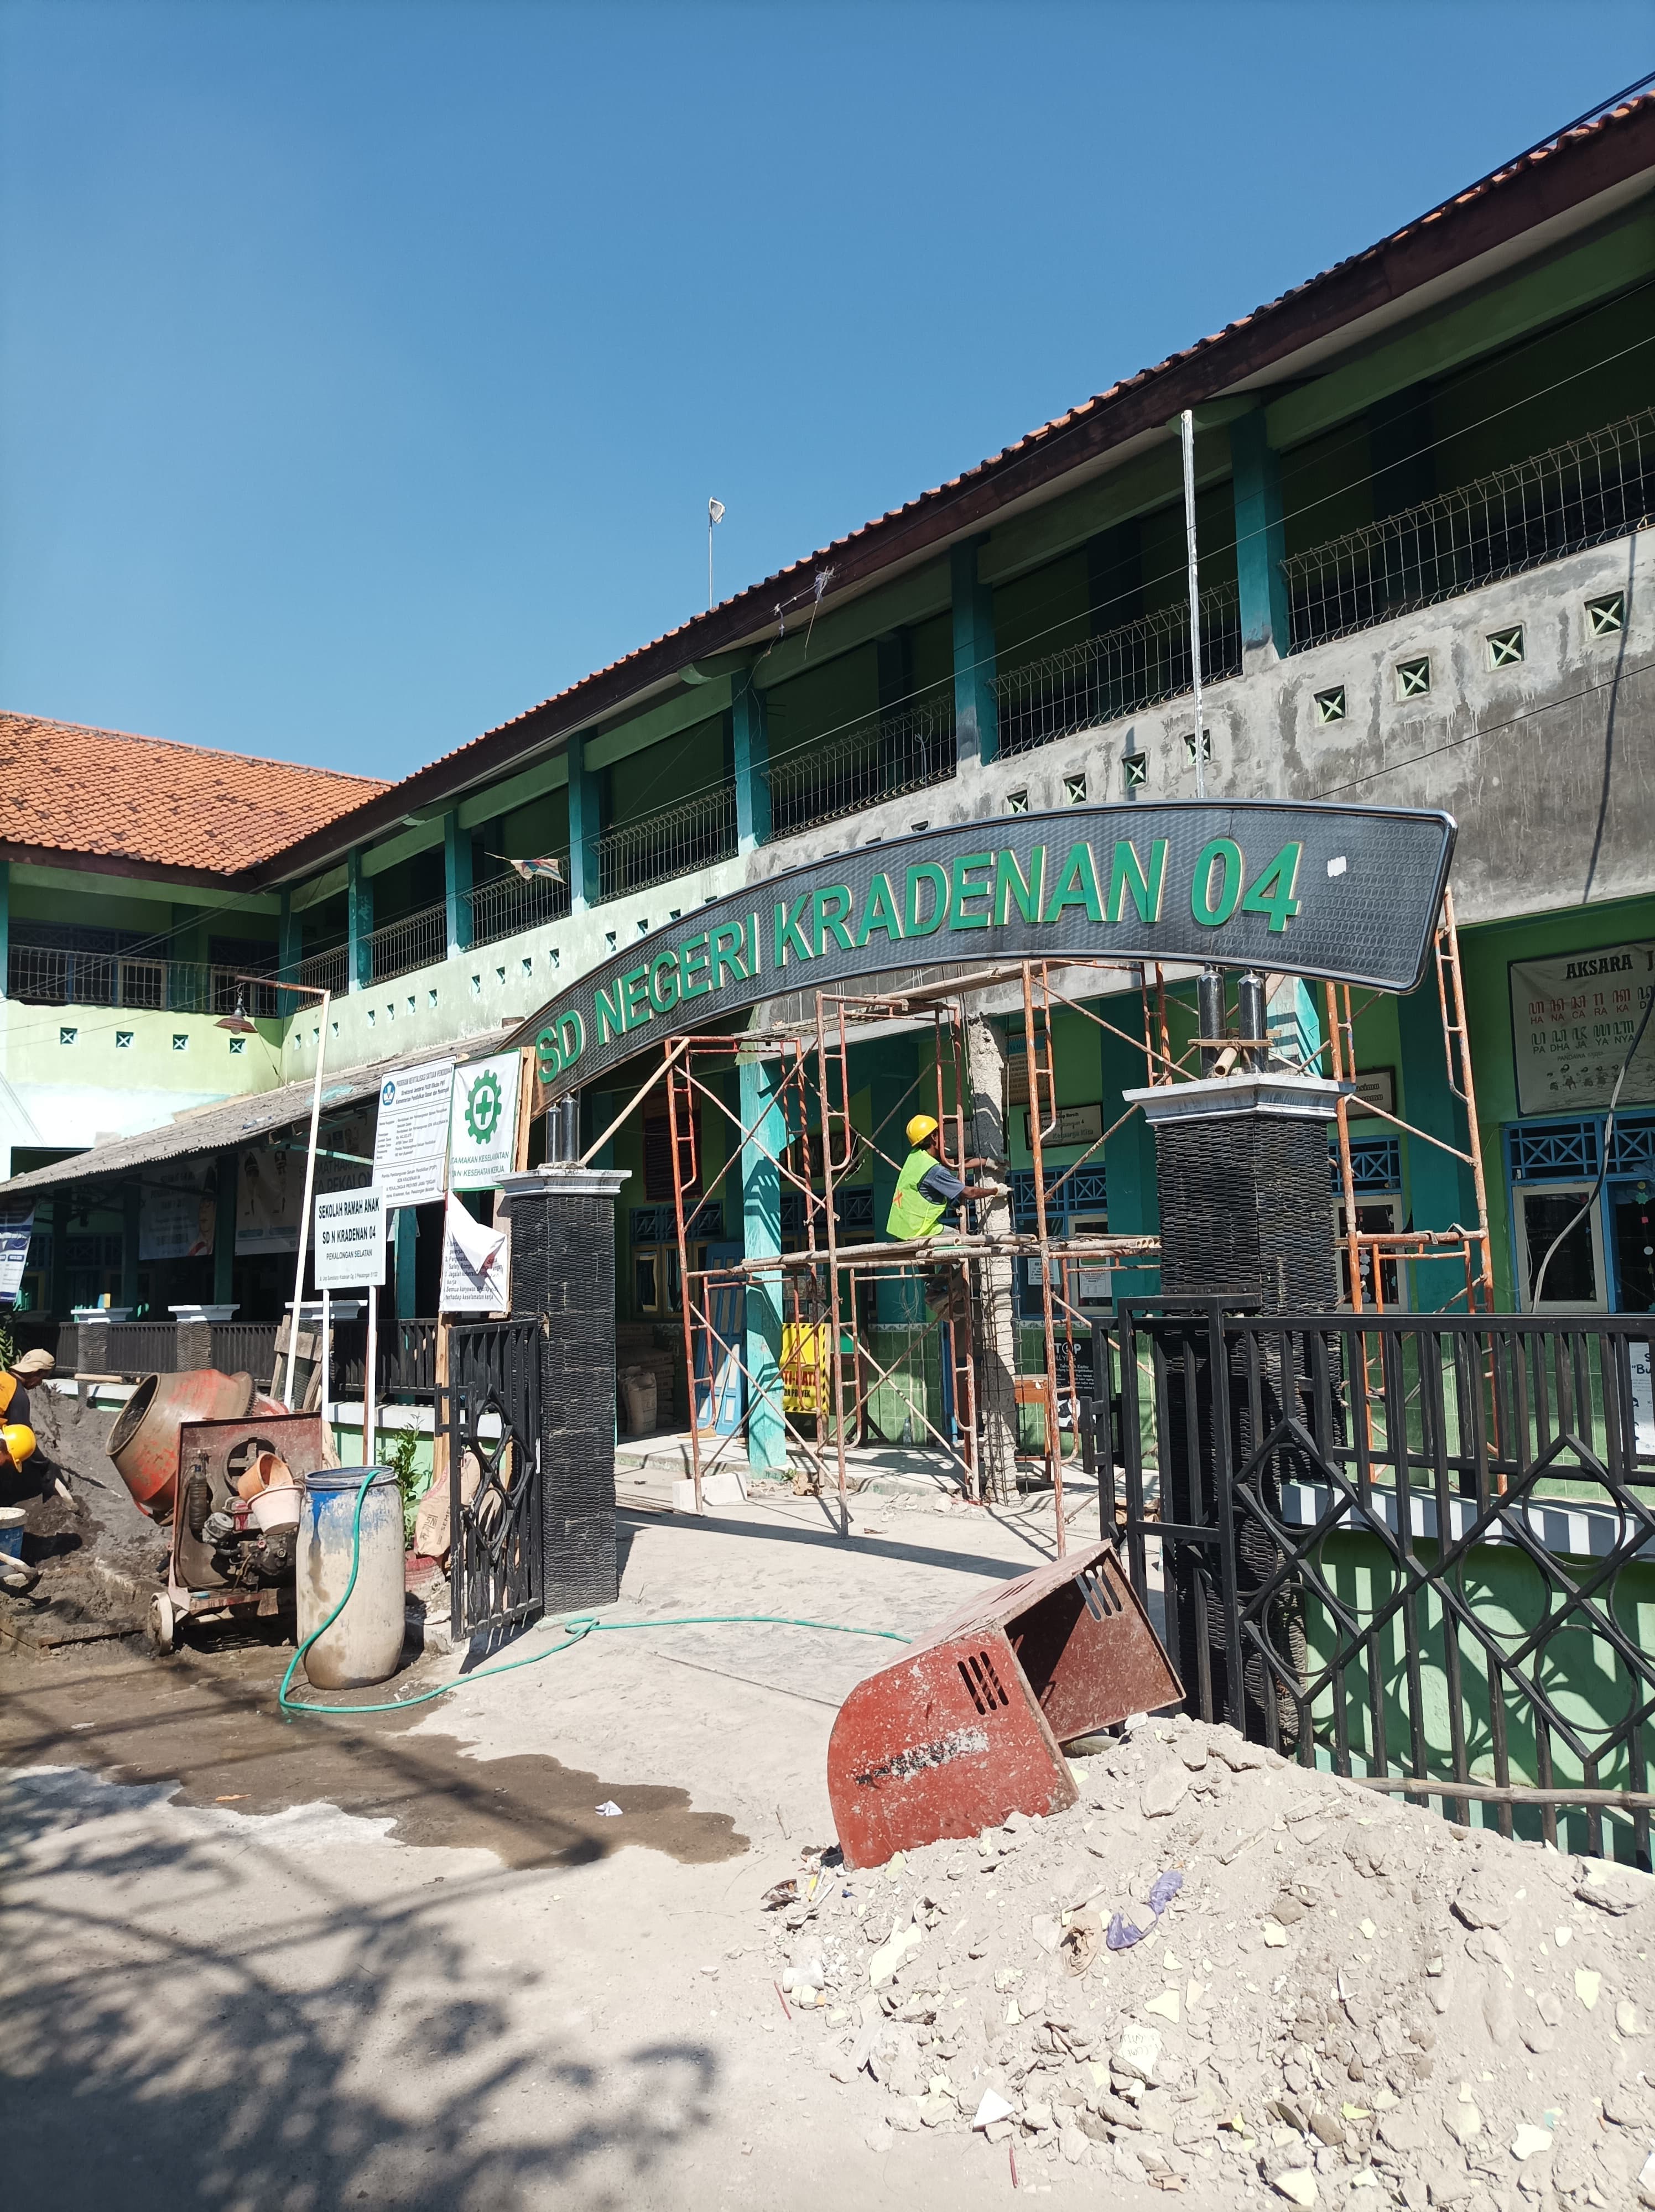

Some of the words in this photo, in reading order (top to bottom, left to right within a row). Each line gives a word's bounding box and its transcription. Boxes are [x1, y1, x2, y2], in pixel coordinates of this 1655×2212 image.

[535, 1009, 585, 1083] SD
[594, 912, 762, 1046] NEGERI
[775, 838, 1169, 968] KRADENAN
[1191, 837, 1304, 932] 04
[1566, 954, 1633, 979] AKSARA
[1647, 951, 1654, 971] J
[1531, 1016, 1544, 1024] HA
[1551, 1013, 1564, 1021] NA
[1572, 1010, 1585, 1019] CA
[1594, 1008, 1607, 1016] RA
[1616, 1004, 1629, 1013] KA
[1533, 1046, 1545, 1054] PA
[1550, 1044, 1570, 1052] DHA
[1615, 1035, 1635, 1044] NYA
[1557, 1052, 1586, 1061] PANDAWA
[1356, 1083, 1380, 1092] asimu
[451, 1156, 478, 1164] TAMAKAN
[478, 1151, 509, 1162] KESELAMATAN
[463, 1167, 491, 1177] KESEHATAN
[491, 1165, 504, 1173] KERJA
[319, 1202, 343, 1219] SEKOLAH
[344, 1199, 363, 1216] RAMAH
[364, 1197, 379, 1213] ANAK
[322, 1231, 330, 1244] SD
[331, 1230, 335, 1244] N
[337, 1226, 368, 1242] KRADENAN
[369, 1225, 376, 1239] 04
[326, 1251, 353, 1261] PEKALONGAN
[354, 1249, 372, 1258] SELATAN
